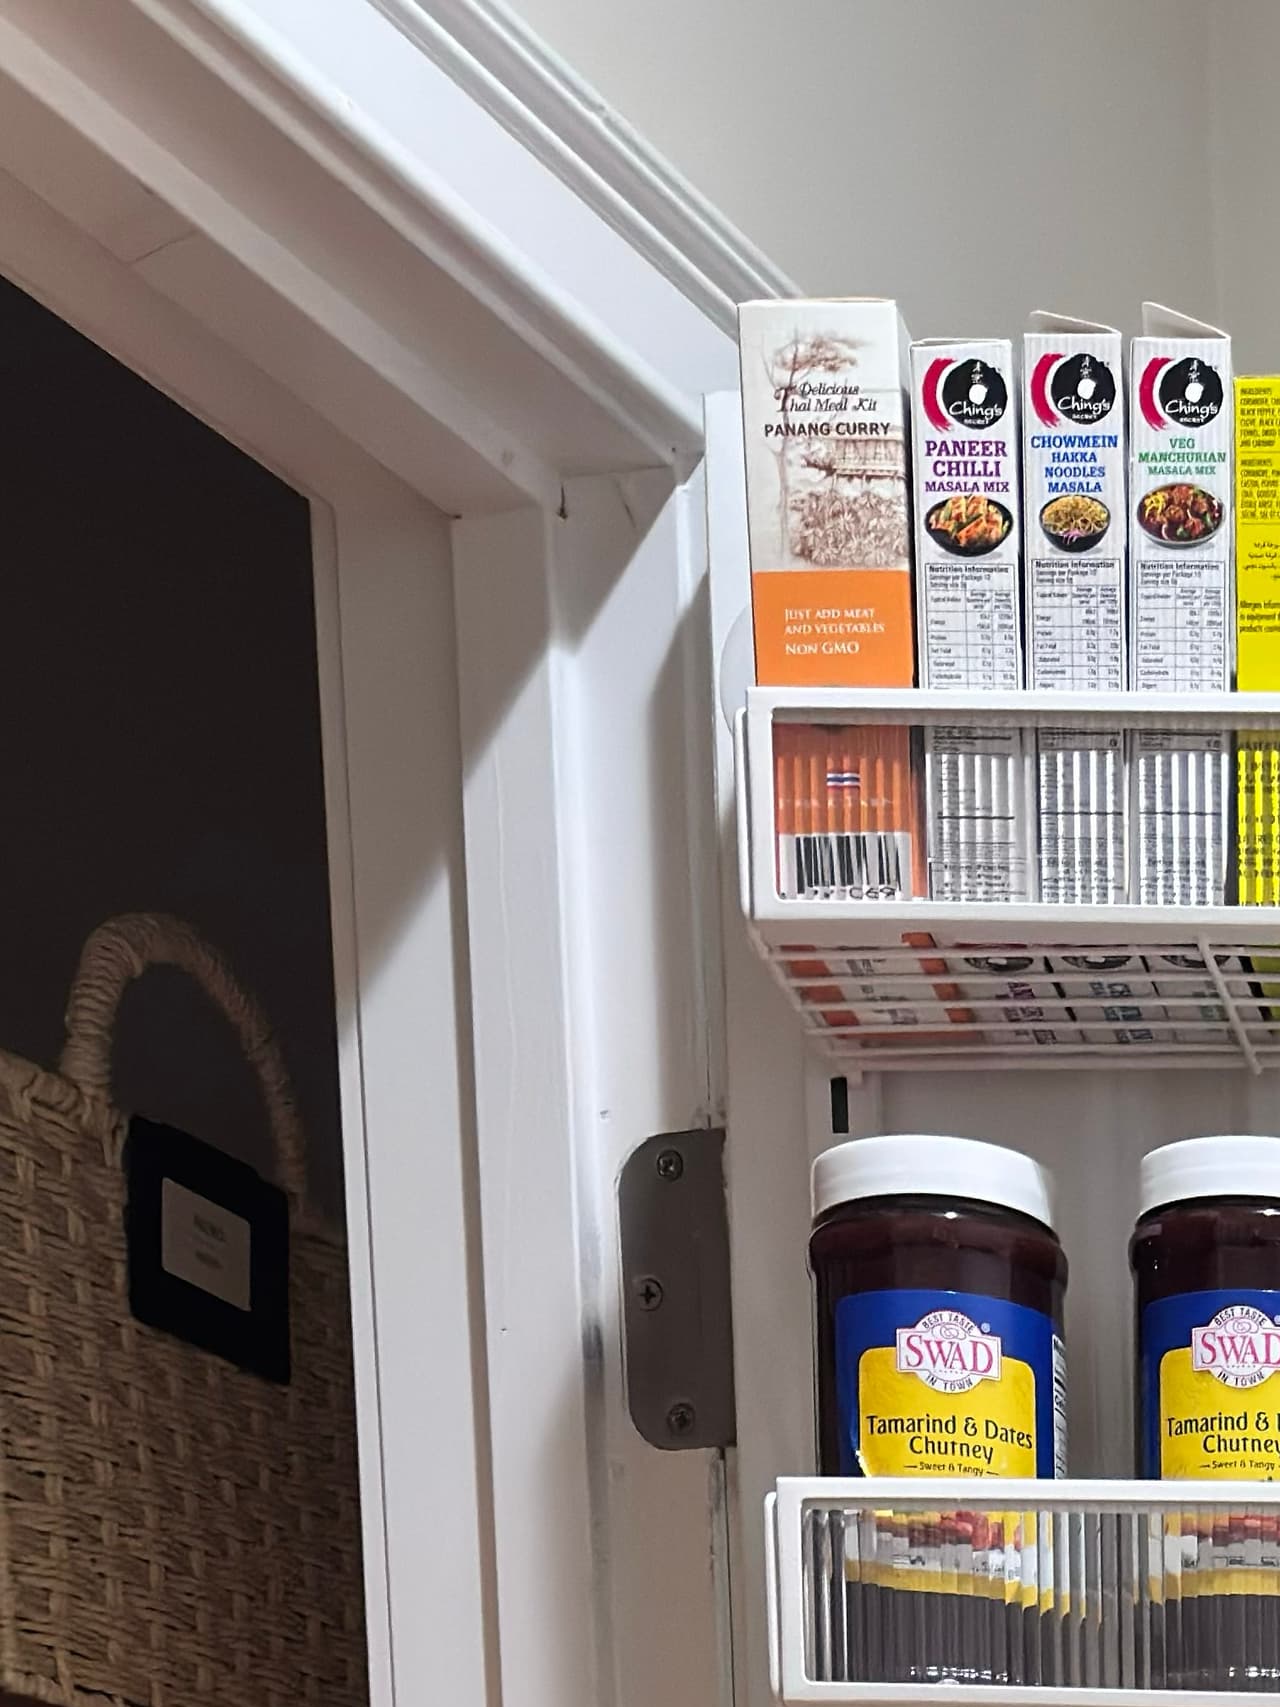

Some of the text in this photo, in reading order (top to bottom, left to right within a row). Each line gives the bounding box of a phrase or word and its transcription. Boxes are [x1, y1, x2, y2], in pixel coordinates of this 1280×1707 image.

[800, 382, 859, 396] Delicious
[815, 399, 847, 411] Meal
[852, 399, 877, 411] Kit
[949, 401, 1002, 420] Ching's
[1058, 397, 1110, 415] Ching's
[1165, 399, 1218, 418] Ching's
[764, 422, 890, 437] PANANG CURRY
[925, 440, 1007, 458] PANEER
[1030, 435, 1118, 449] CHOWMEIN
[1169, 438, 1195, 449] VEG
[1052, 452, 1097, 463] HAKKA
[1138, 452, 1226, 463] MANCHURIAN
[932, 461, 1001, 477] CHILLI
[1045, 466, 1105, 478] NOODLES
[1147, 466, 1216, 476] MASALA MIX
[925, 482, 1009, 493] MASALA MIX
[1048, 482, 1102, 493] MASALA
[785, 608, 875, 621] JUST ADD MEAT
[785, 622, 885, 634] AND VEGETABLES
[785, 640, 859, 655] NON GMO
[922, 1313, 974, 1332] BEST TASTE
[906, 1334, 993, 1374] SWAD
[926, 1375, 973, 1391] IN TOWN
[866, 1414, 1033, 1449] Tamarind & Dates
[1168, 1411, 1247, 1438] Tamarind
[1255, 1412, 1269, 1431] &
[909, 1436, 993, 1464] Chutney
